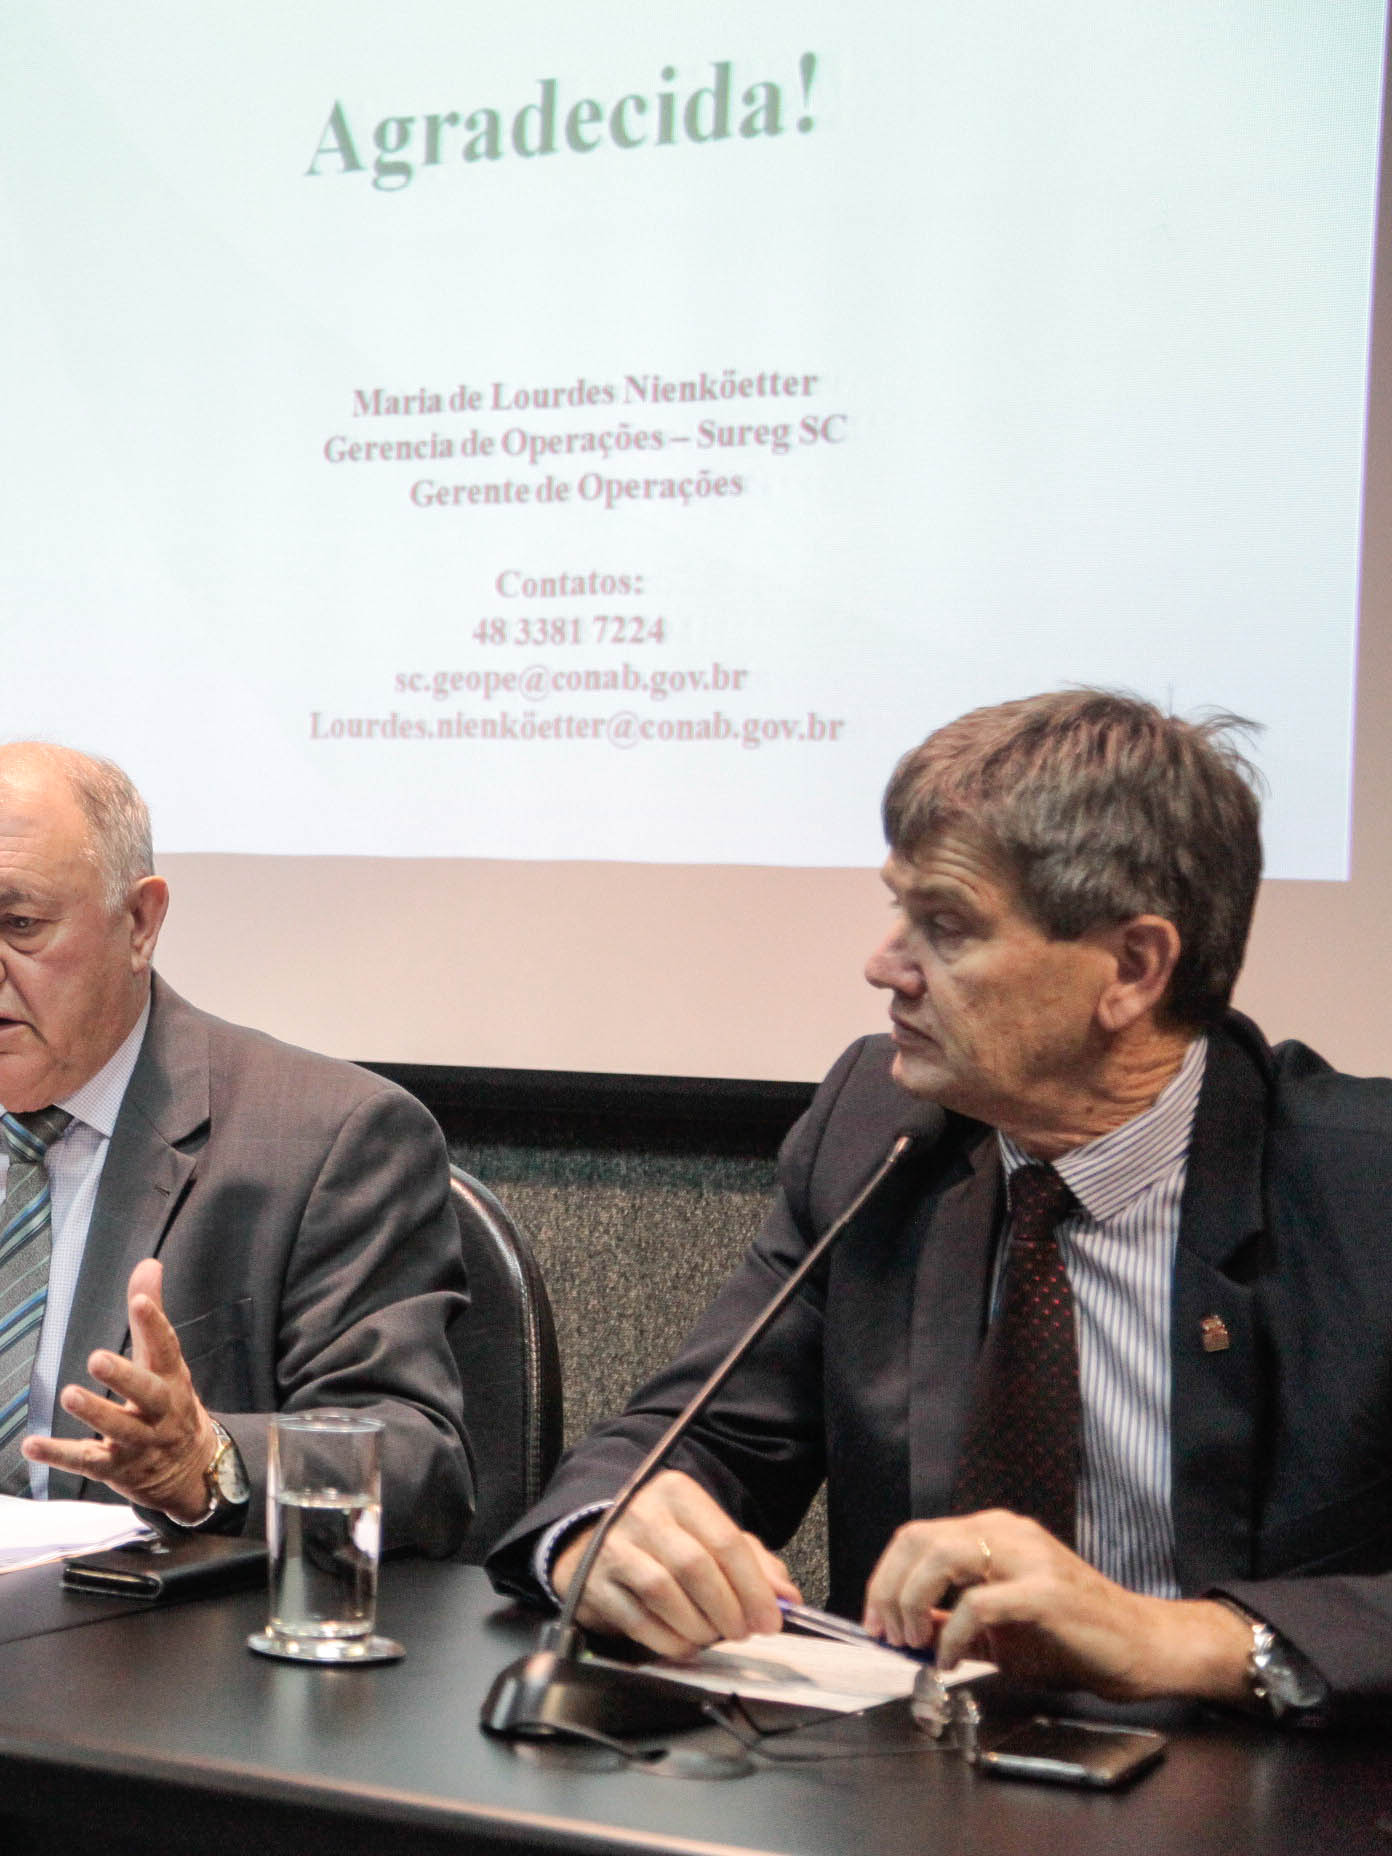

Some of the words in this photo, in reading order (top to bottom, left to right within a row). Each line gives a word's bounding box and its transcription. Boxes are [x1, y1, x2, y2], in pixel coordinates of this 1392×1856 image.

[305, 51, 817, 191] Agradecida!
[353, 386, 442, 417] Maria
[449, 384, 482, 411] de
[491, 378, 615, 410] Lourdes
[324, 433, 454, 463] Gerencia
[461, 430, 494, 457] de
[502, 423, 663, 464] Operações
[698, 418, 790, 454] Sureg
[799, 414, 847, 444] SC
[410, 479, 529, 507] Gerente
[536, 475, 570, 503] de
[577, 470, 744, 509] Operações
[496, 570, 644, 599] Contatos:
[472, 618, 507, 645] 48
[514, 617, 583, 645] 3381
[594, 616, 665, 645] 7224
[394, 663, 749, 700] sc.geope@conab.gov.br
